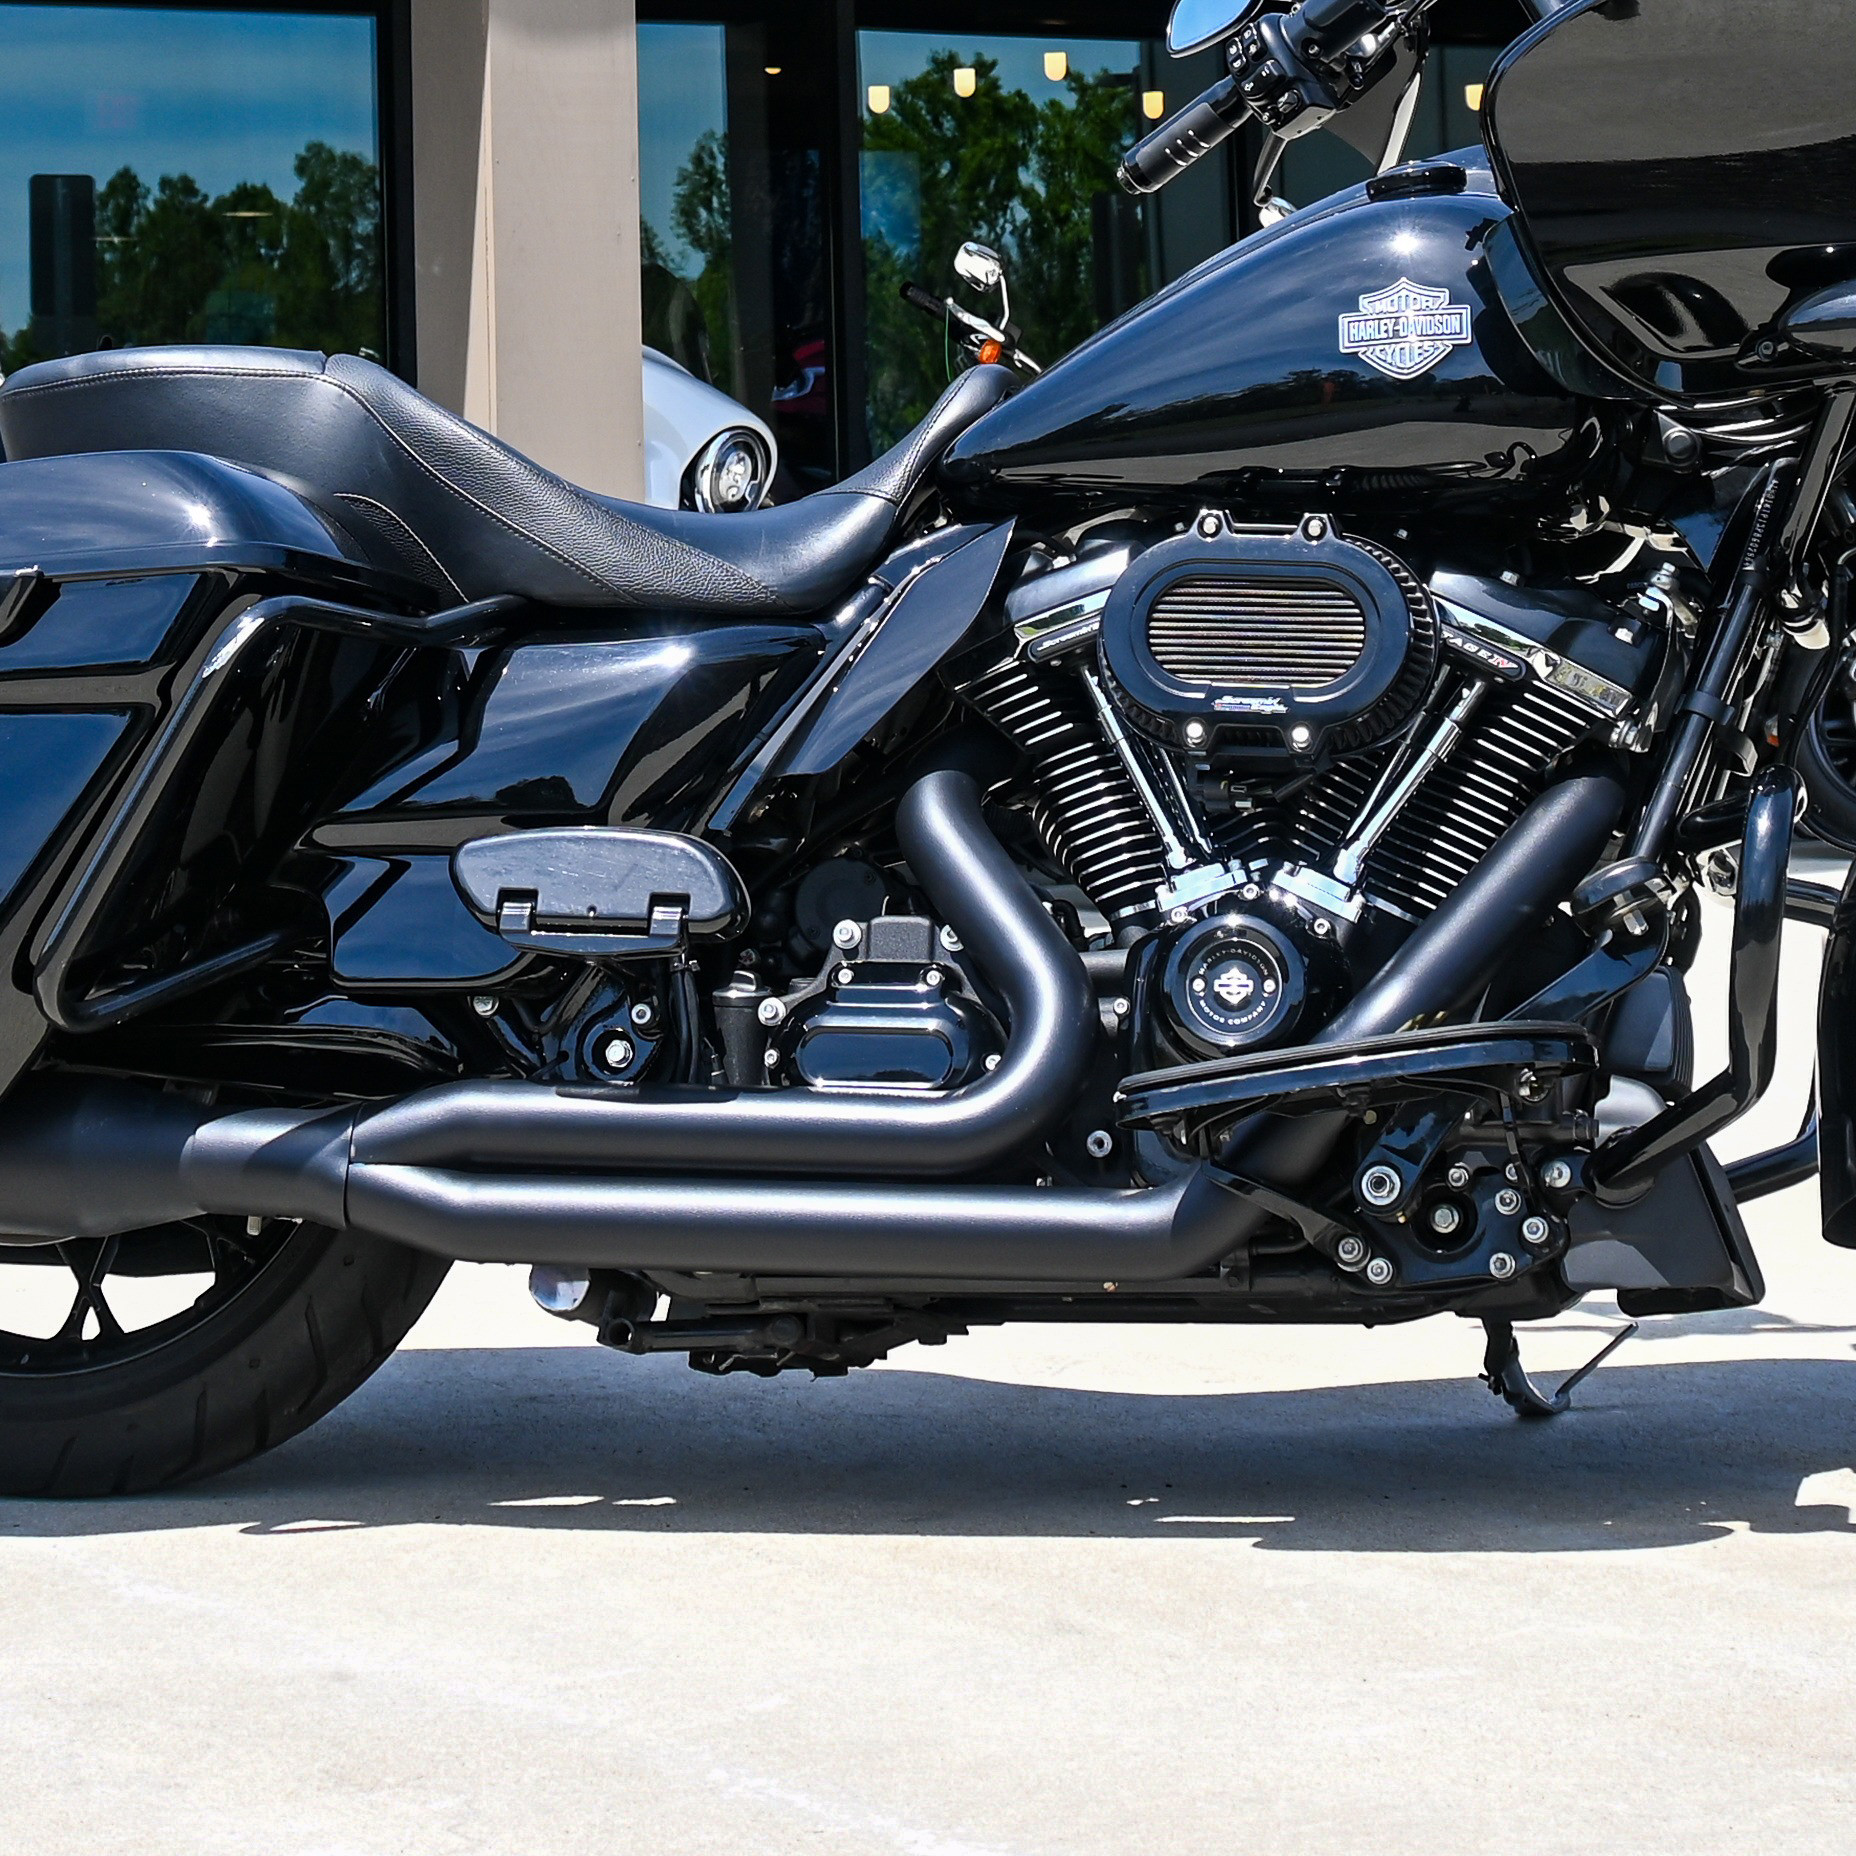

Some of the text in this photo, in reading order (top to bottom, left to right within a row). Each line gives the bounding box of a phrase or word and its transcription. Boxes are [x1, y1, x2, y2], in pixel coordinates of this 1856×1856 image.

[1374, 293, 1436, 315] MOTOR
[1349, 314, 1461, 342] HARLEY-DAVIDSON
[1374, 340, 1435, 366] CYCLES
[1441, 630, 1493, 660] TAGE
[1199, 999, 1266, 1026] MOTOR COMPANY
